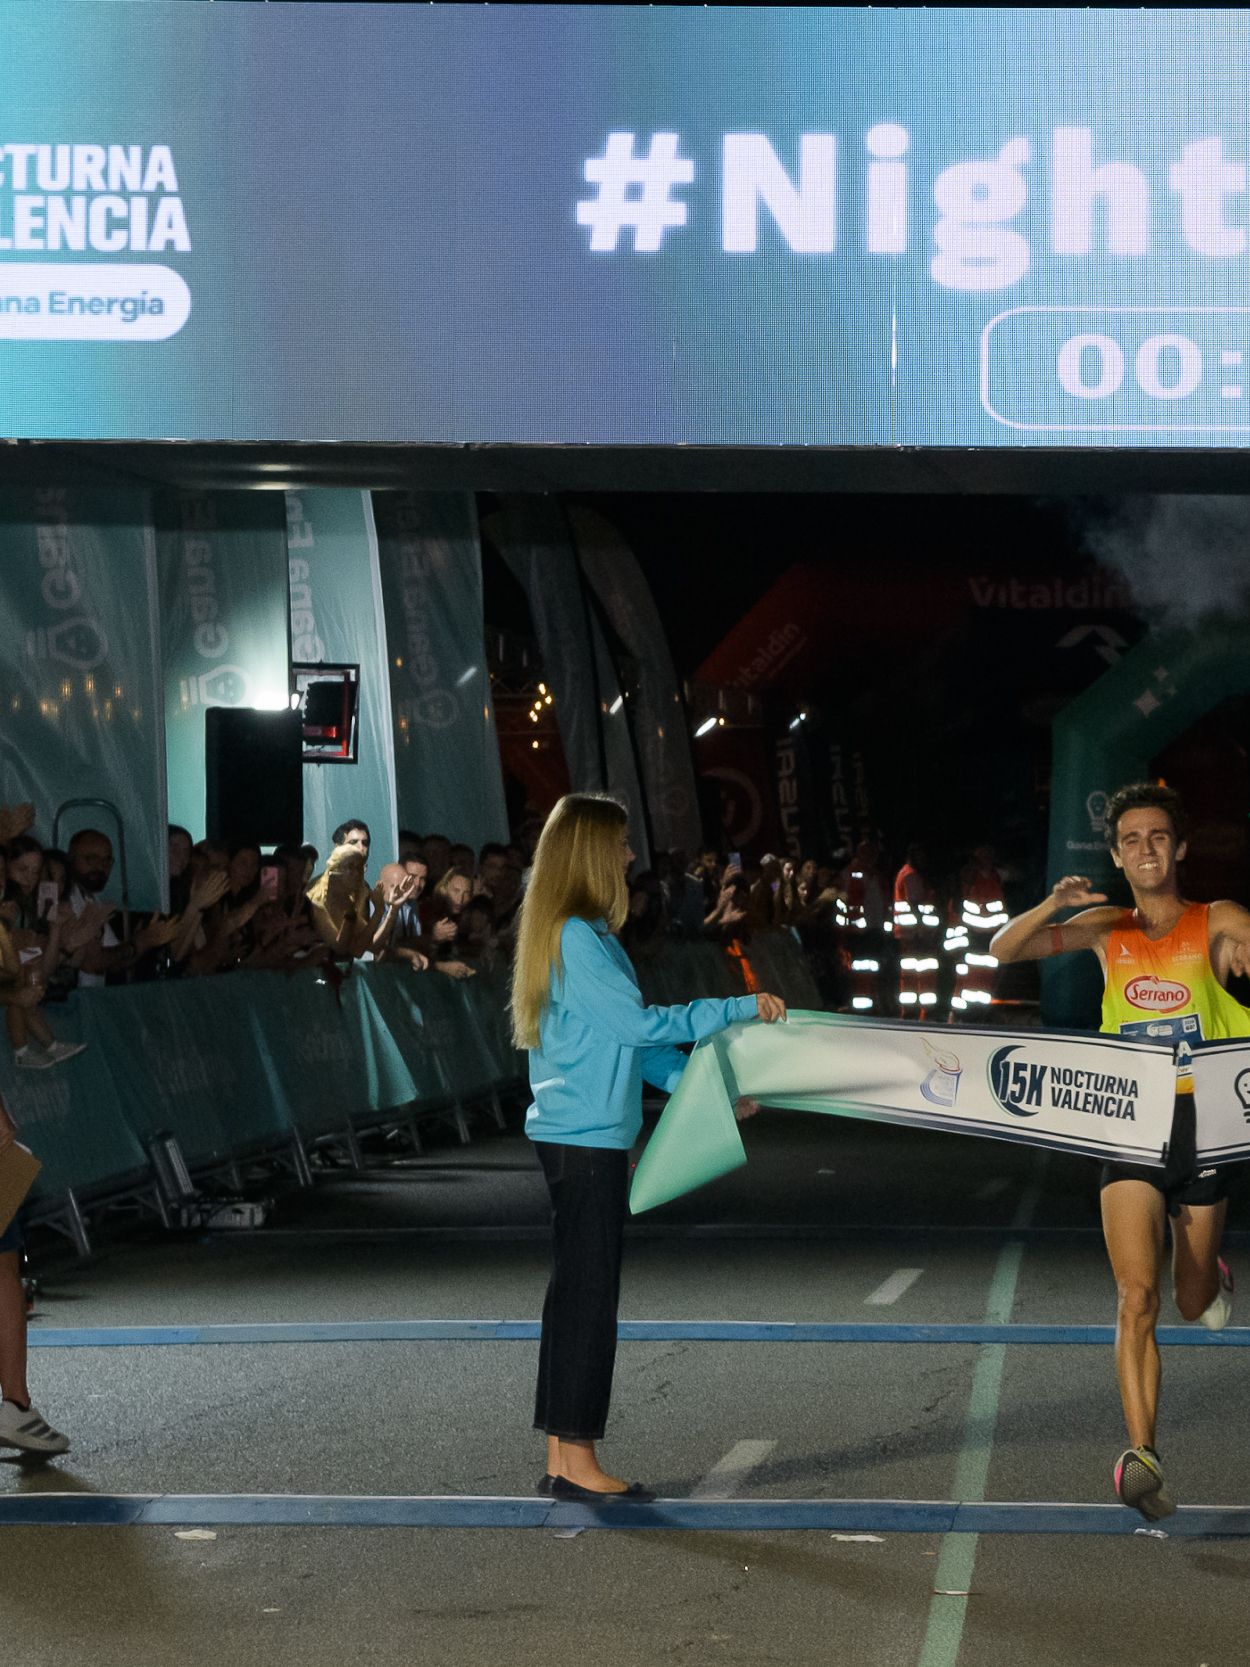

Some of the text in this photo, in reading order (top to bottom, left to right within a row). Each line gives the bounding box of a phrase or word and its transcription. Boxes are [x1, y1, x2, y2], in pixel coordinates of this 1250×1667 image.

[0, 144, 179, 192] TURNA
[48, 290, 164, 323] Energía
[1130, 984, 1185, 1001] Serrano
[1000, 1060, 1048, 1107] 15K
[1050, 1066, 1139, 1099] NOCTURNA
[1050, 1086, 1137, 1122] VALENCIA
